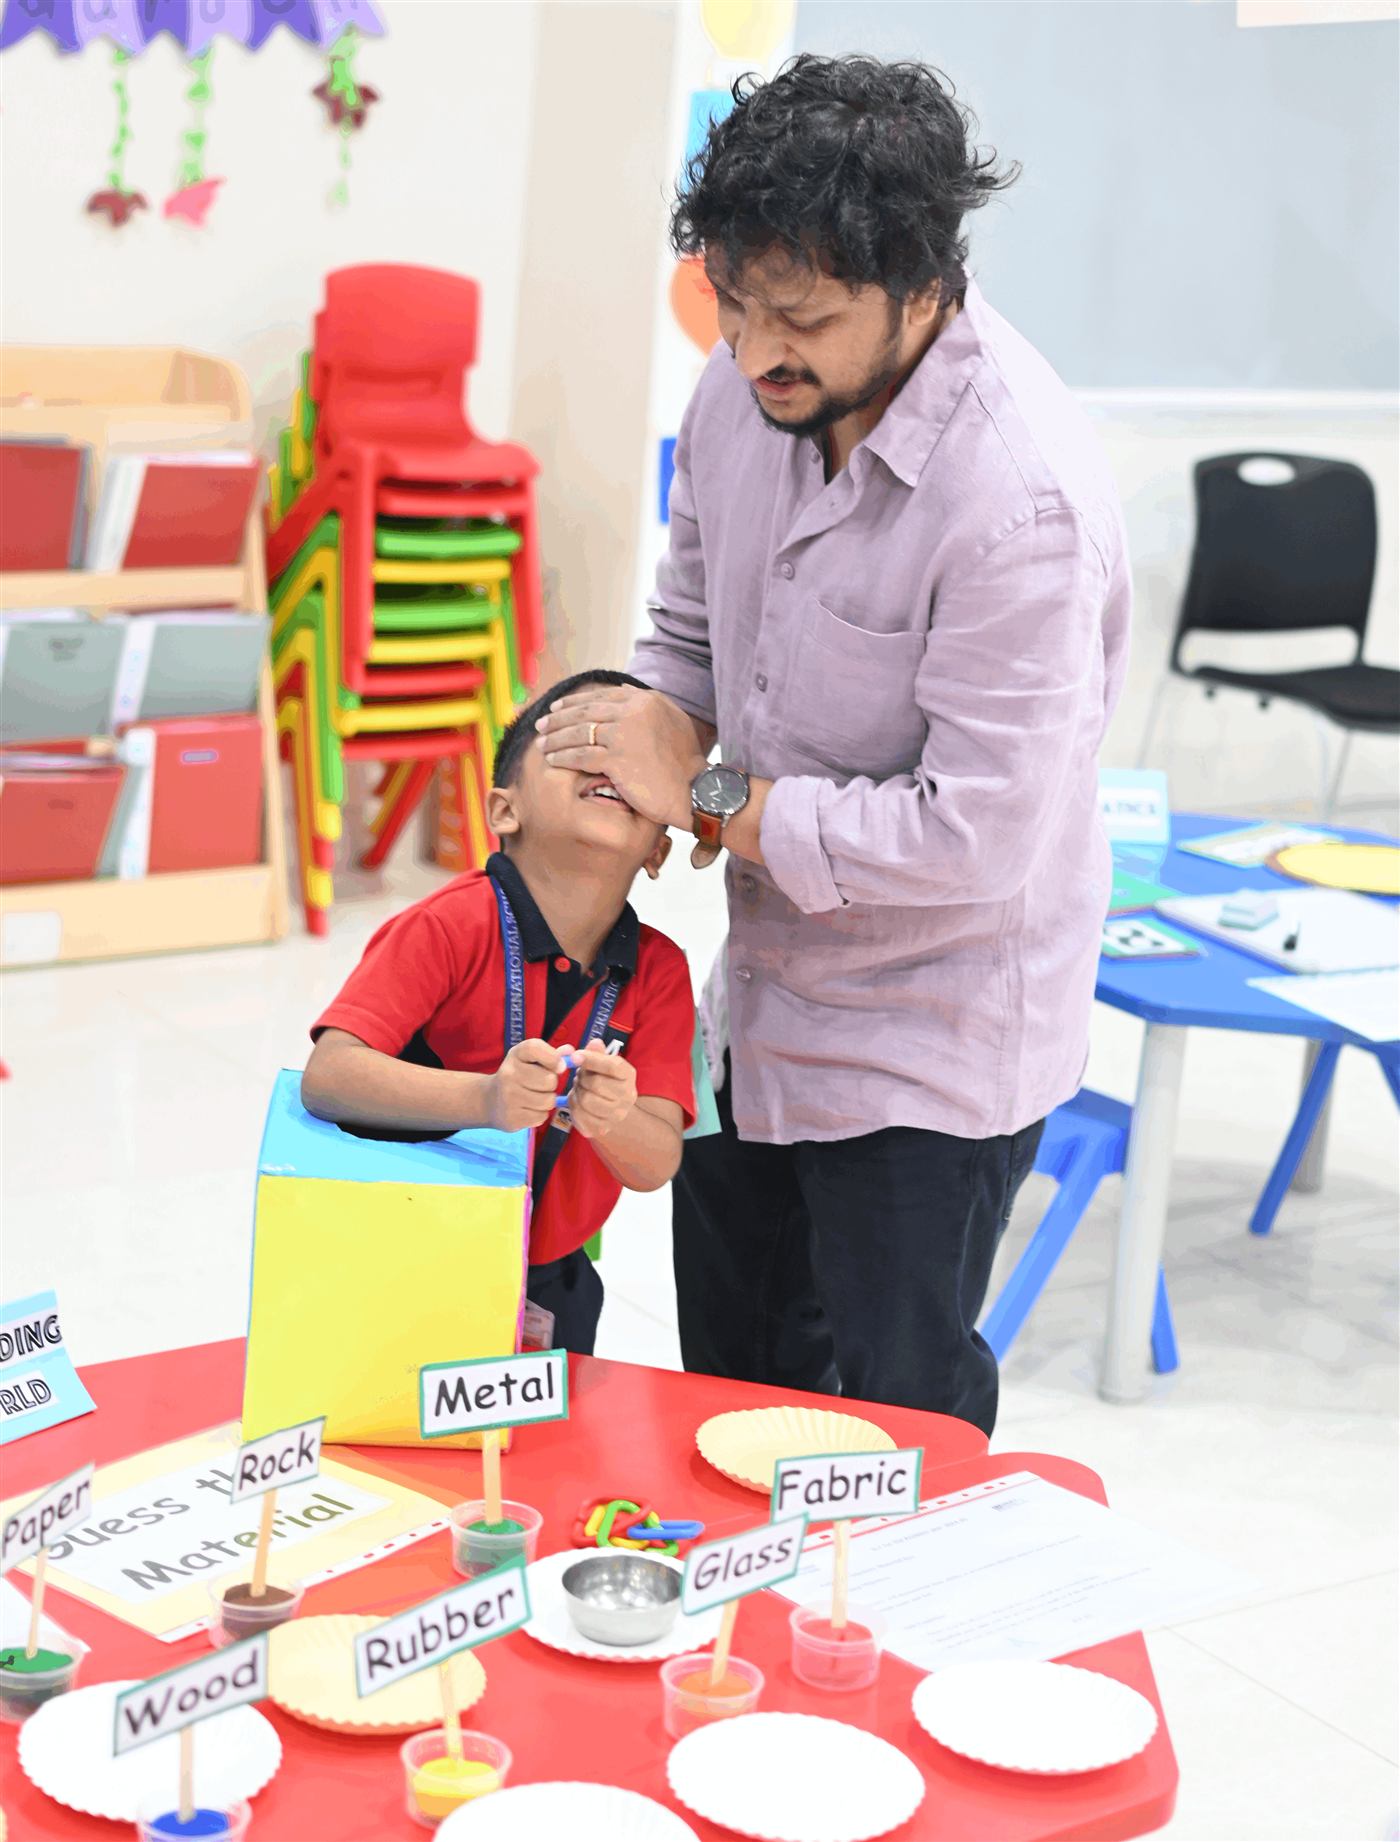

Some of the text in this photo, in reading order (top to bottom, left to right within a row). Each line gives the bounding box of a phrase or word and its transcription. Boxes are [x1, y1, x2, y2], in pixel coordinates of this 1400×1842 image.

[0, 1314, 62, 1362] DING
[434, 1361, 554, 1417] Metal
[238, 1431, 315, 1491] Rock
[777, 1460, 908, 1510] Fabric
[2, 1480, 91, 1559] Paper
[694, 1537, 794, 1591] Glass
[366, 1588, 514, 1679] Rubber
[124, 1649, 258, 1736] Wood
